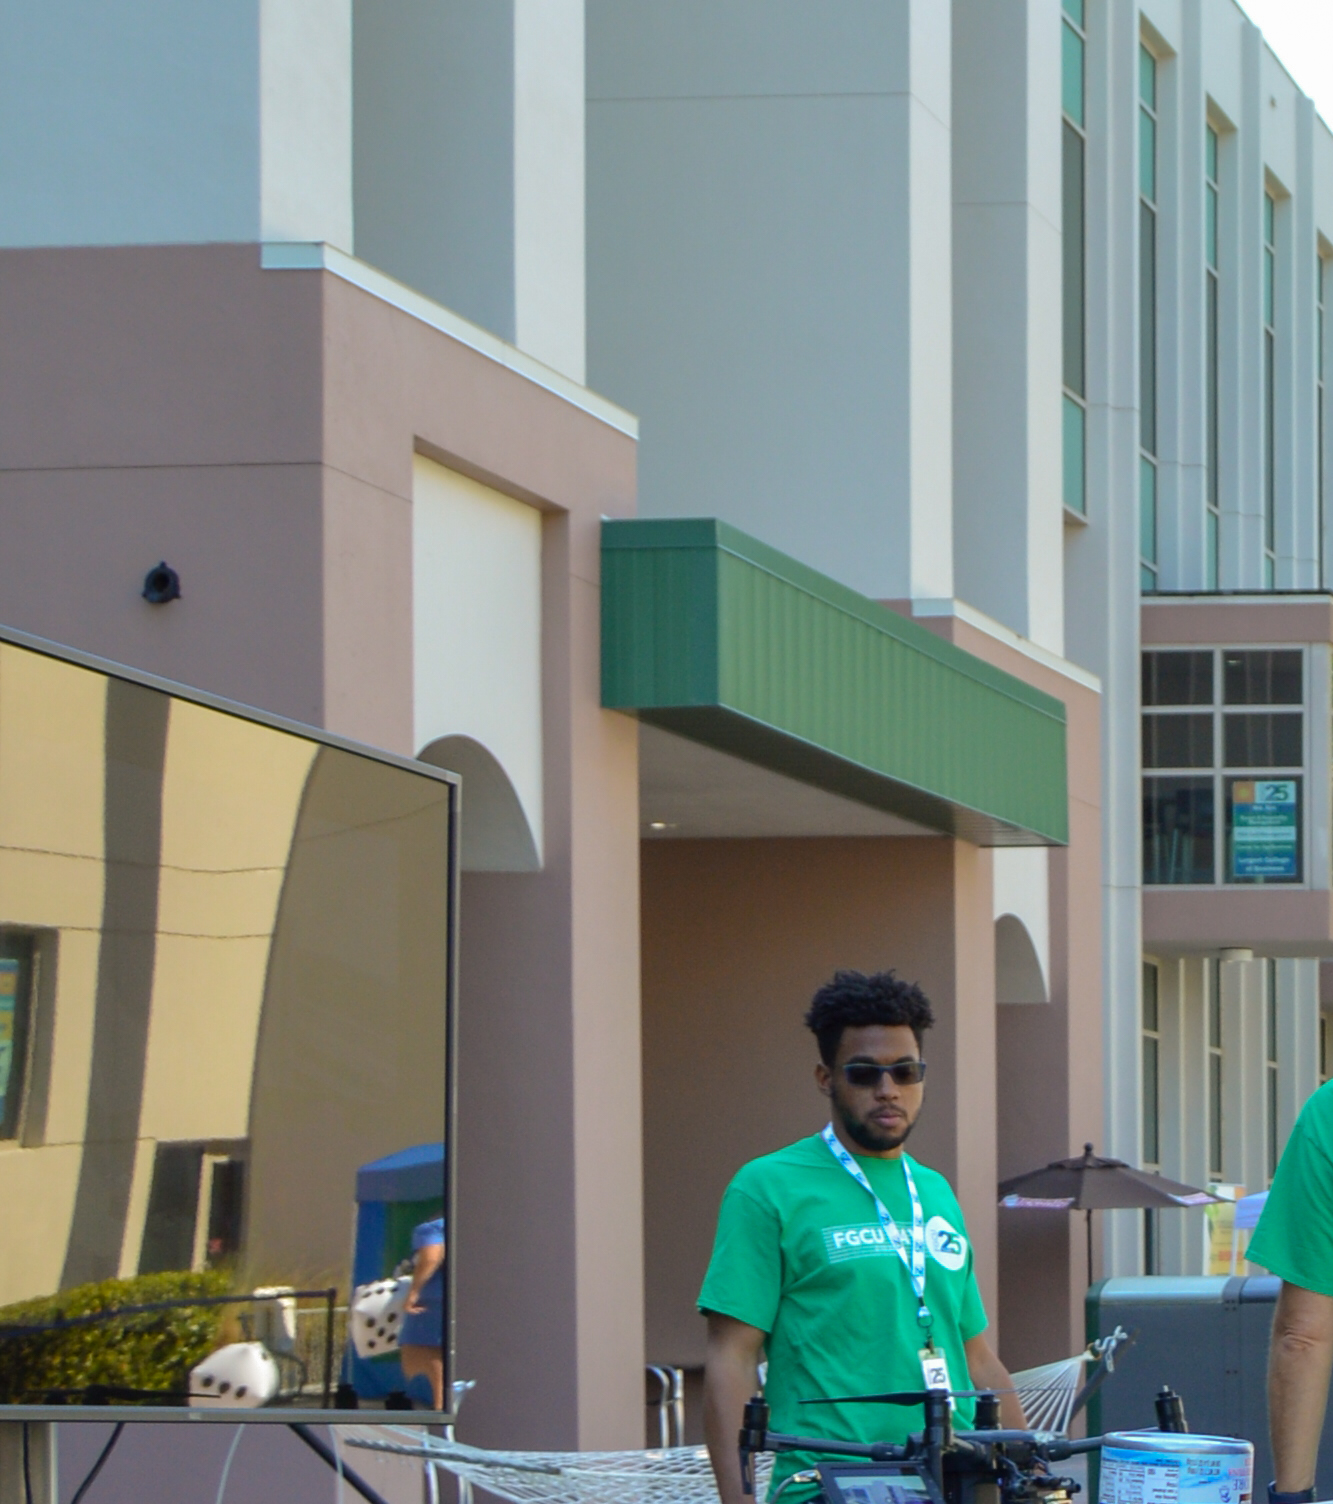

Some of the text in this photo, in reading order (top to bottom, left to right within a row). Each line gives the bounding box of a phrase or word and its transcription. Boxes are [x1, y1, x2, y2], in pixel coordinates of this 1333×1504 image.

[1265, 784, 1288, 801] 25
[833, 1228, 884, 1249] FGCU
[938, 1230, 960, 1255] 25
[931, 1367, 945, 1384] 25
